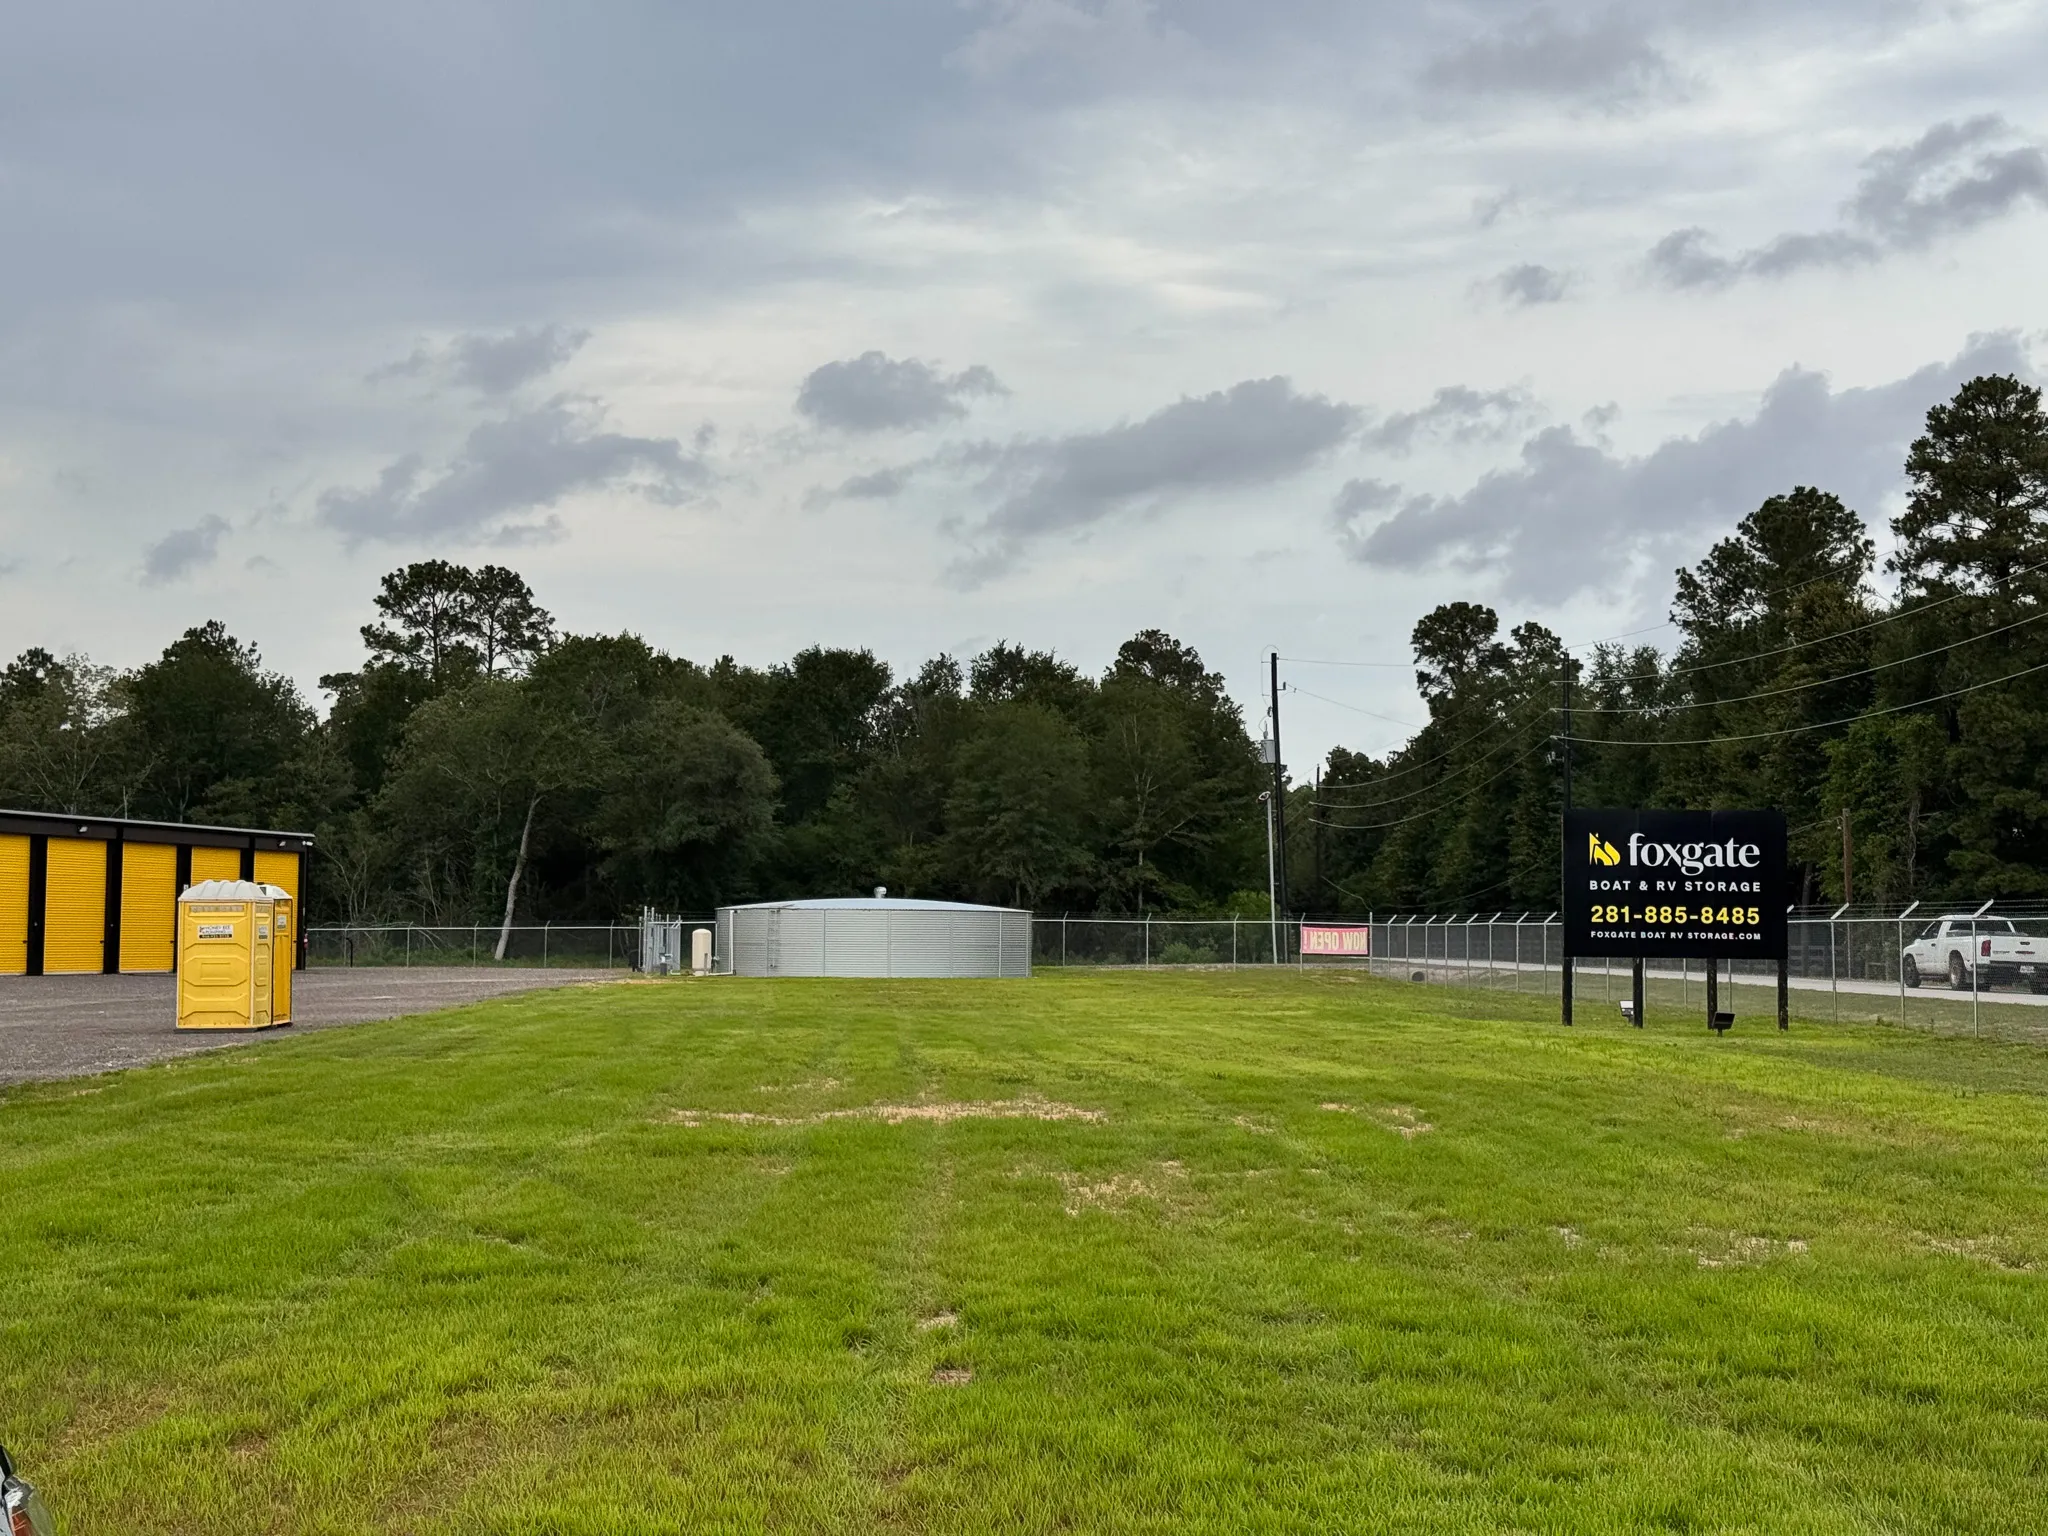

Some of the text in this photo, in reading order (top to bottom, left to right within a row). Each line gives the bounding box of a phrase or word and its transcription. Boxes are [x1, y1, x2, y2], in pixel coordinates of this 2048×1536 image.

[1627, 832, 1761, 876] foxgate
[1589, 880, 1761, 892] BOAT & RV STORAGE
[1590, 905, 1760, 925] 281-885-8485
[1590, 930, 1761, 940] FOXGATE BOAT RV STORAGE.COM
